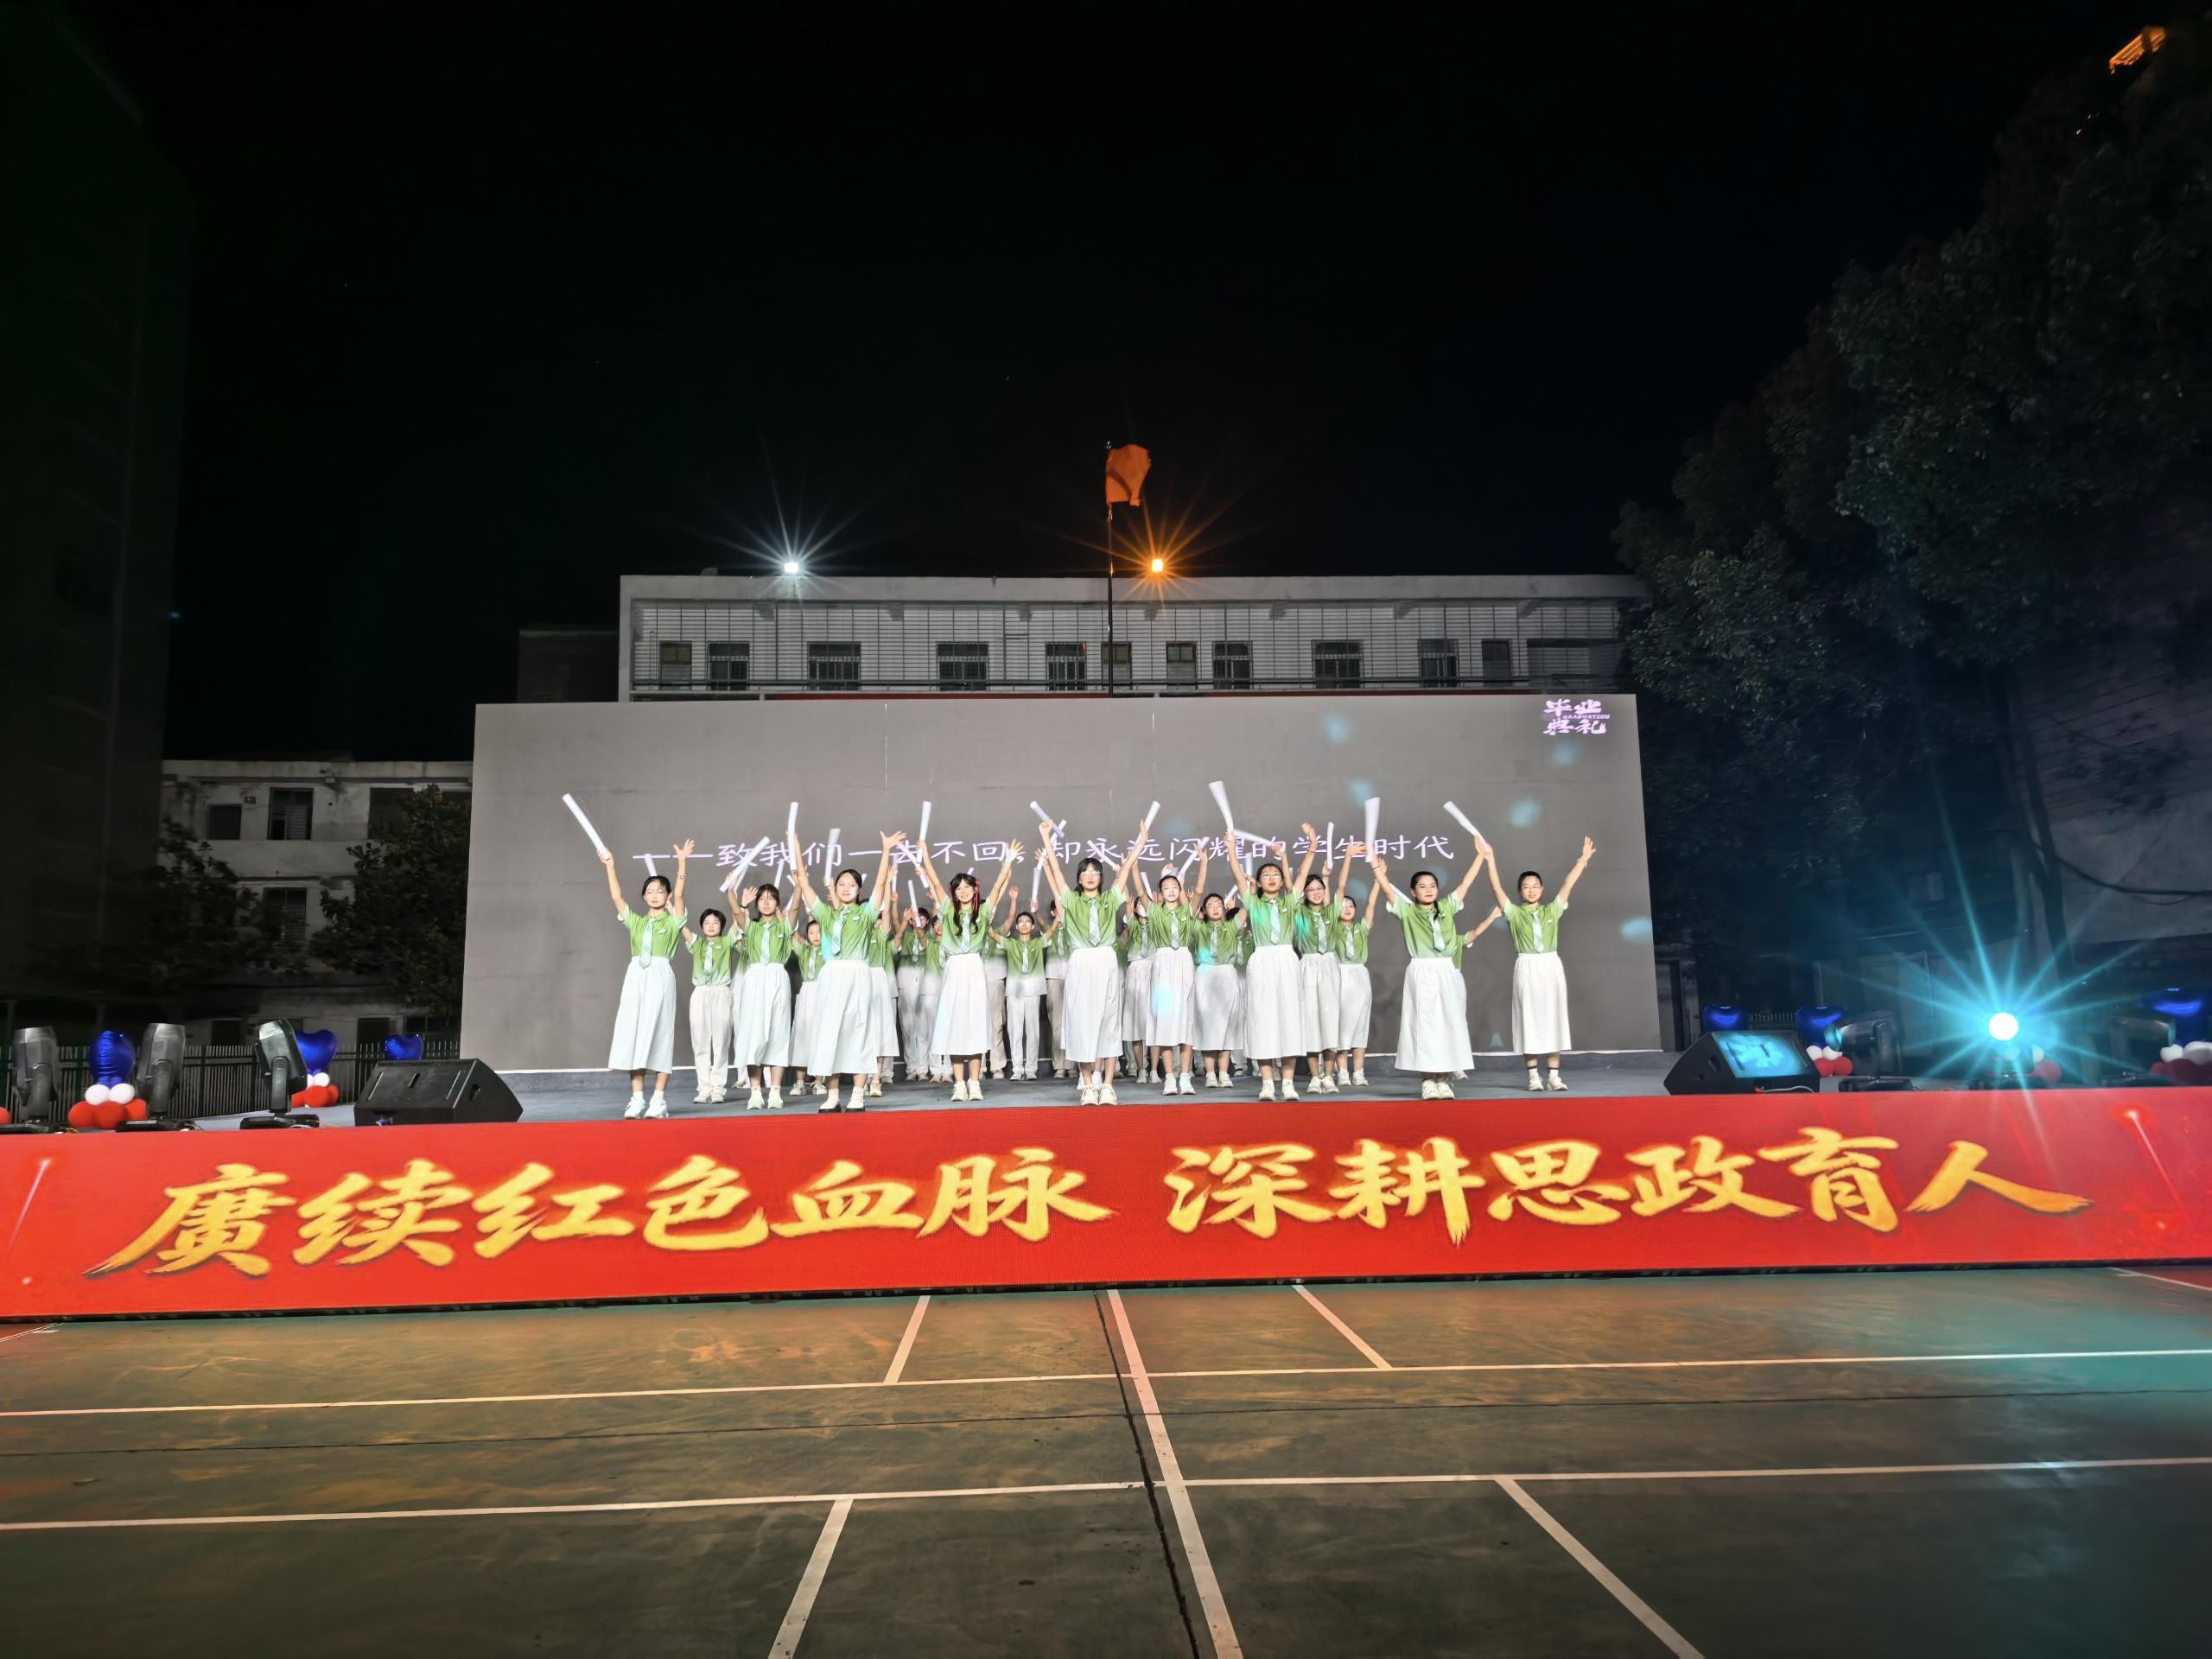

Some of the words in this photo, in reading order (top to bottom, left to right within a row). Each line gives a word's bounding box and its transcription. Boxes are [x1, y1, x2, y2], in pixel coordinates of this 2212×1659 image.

[1543, 698, 1602, 717] 毕业
[1163, 1126, 2093, 1245] 深耕思政育人
